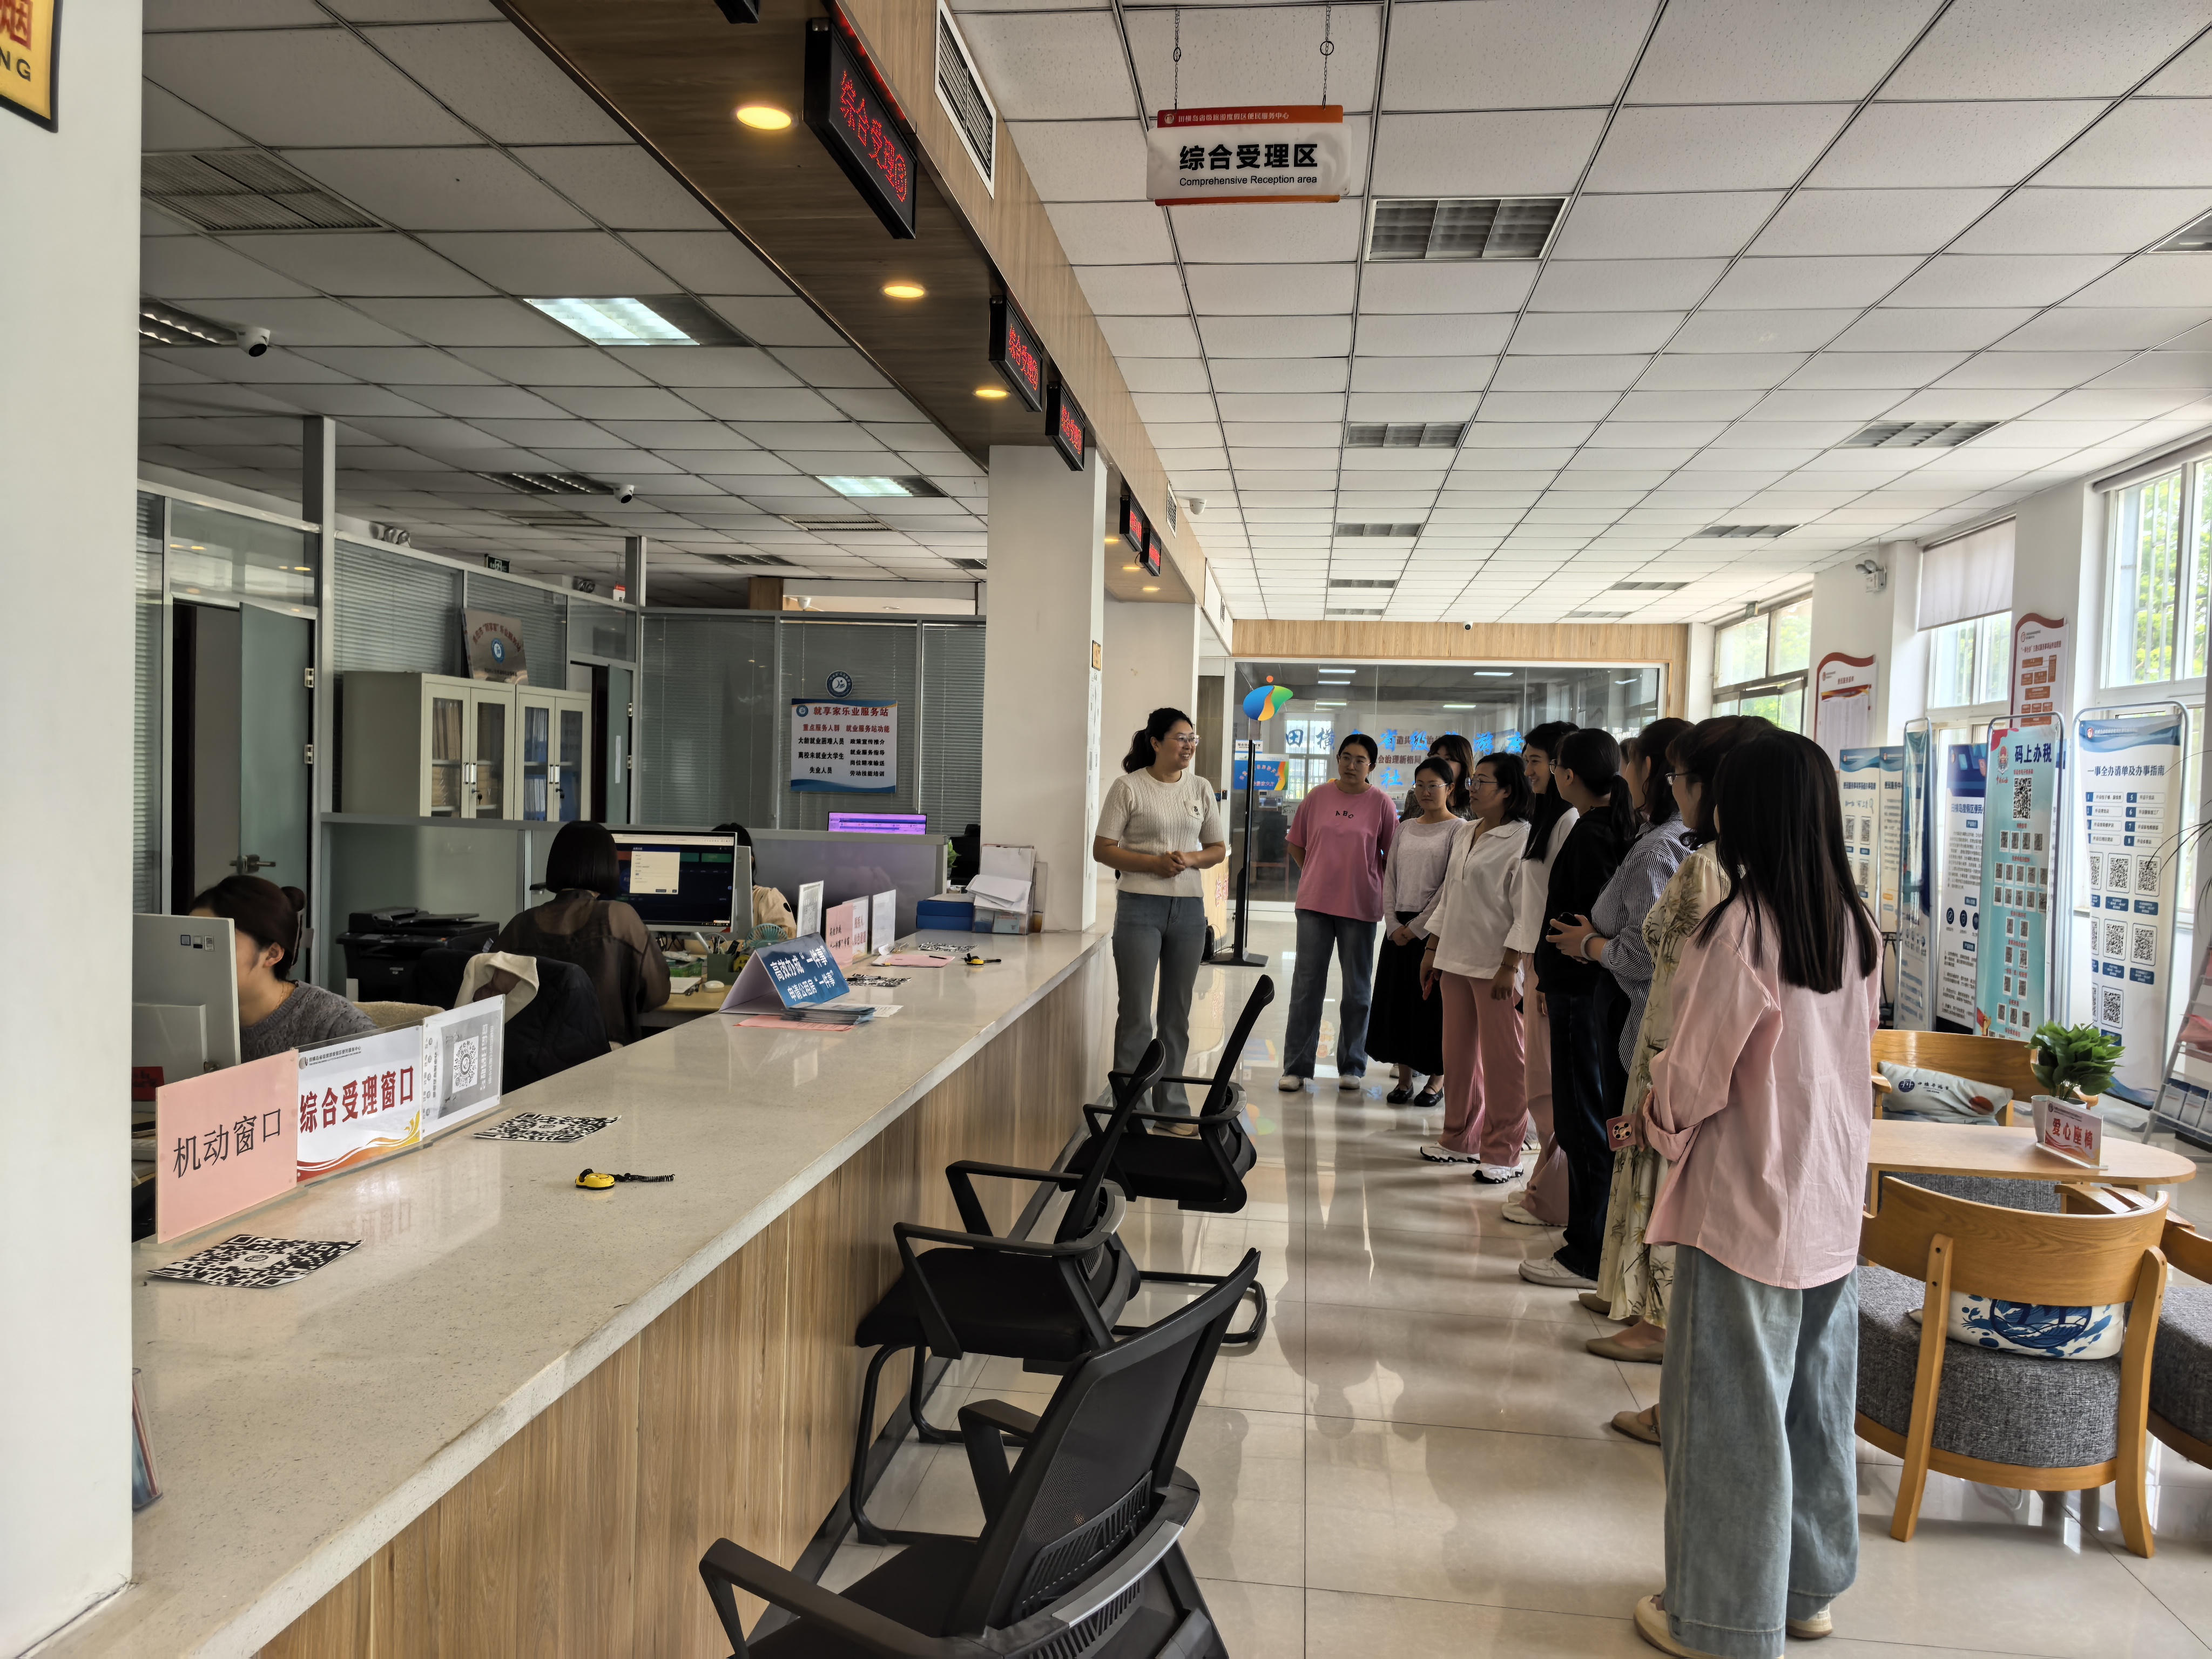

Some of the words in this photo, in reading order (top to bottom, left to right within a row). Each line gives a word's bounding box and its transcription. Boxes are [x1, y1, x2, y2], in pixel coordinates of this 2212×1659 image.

[1179, 144, 1318, 171] 综合受理区
[1179, 176, 1247, 187] Comprehensive
[1250, 175, 1294, 185] Reception
[814, 706, 889, 717] 就享家乐业服务站
[846, 725, 890, 733] 就业服务站功能
[798, 752, 844, 760] 离校未就业大学生
[2015, 743, 2052, 764] 码上办税
[2087, 765, 2165, 777] 一事全办清单及办事指南
[300, 1065, 414, 1134] 综合受理窗口
[2052, 1118, 2093, 1150] 爱心座椅
[173, 1108, 282, 1178] 机动窗口
